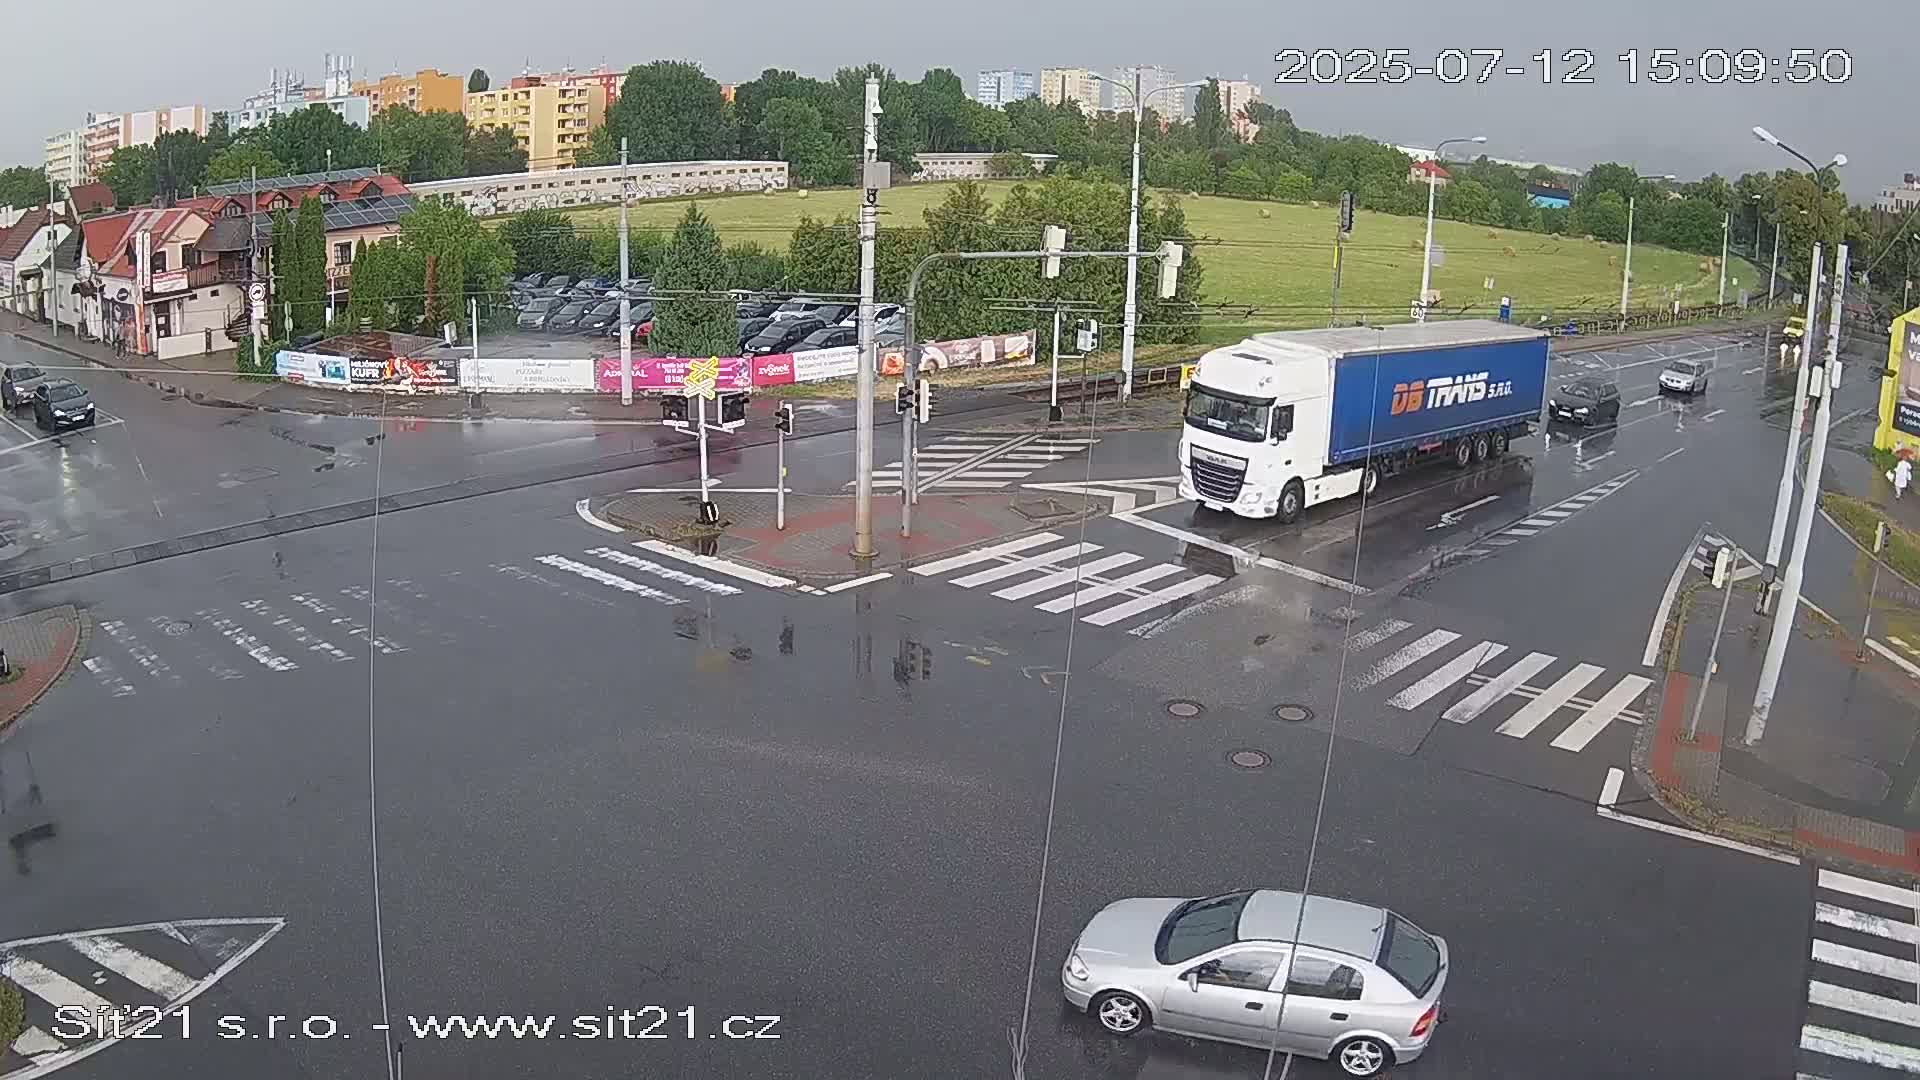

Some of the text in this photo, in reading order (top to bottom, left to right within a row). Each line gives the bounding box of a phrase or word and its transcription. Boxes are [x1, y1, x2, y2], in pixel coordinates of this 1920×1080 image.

[351, 368, 380, 378] KUFR
[603, 369, 649, 378] ADMRAL
[1391, 379, 1425, 416] DB
[1426, 371, 1489, 410] TRANS
